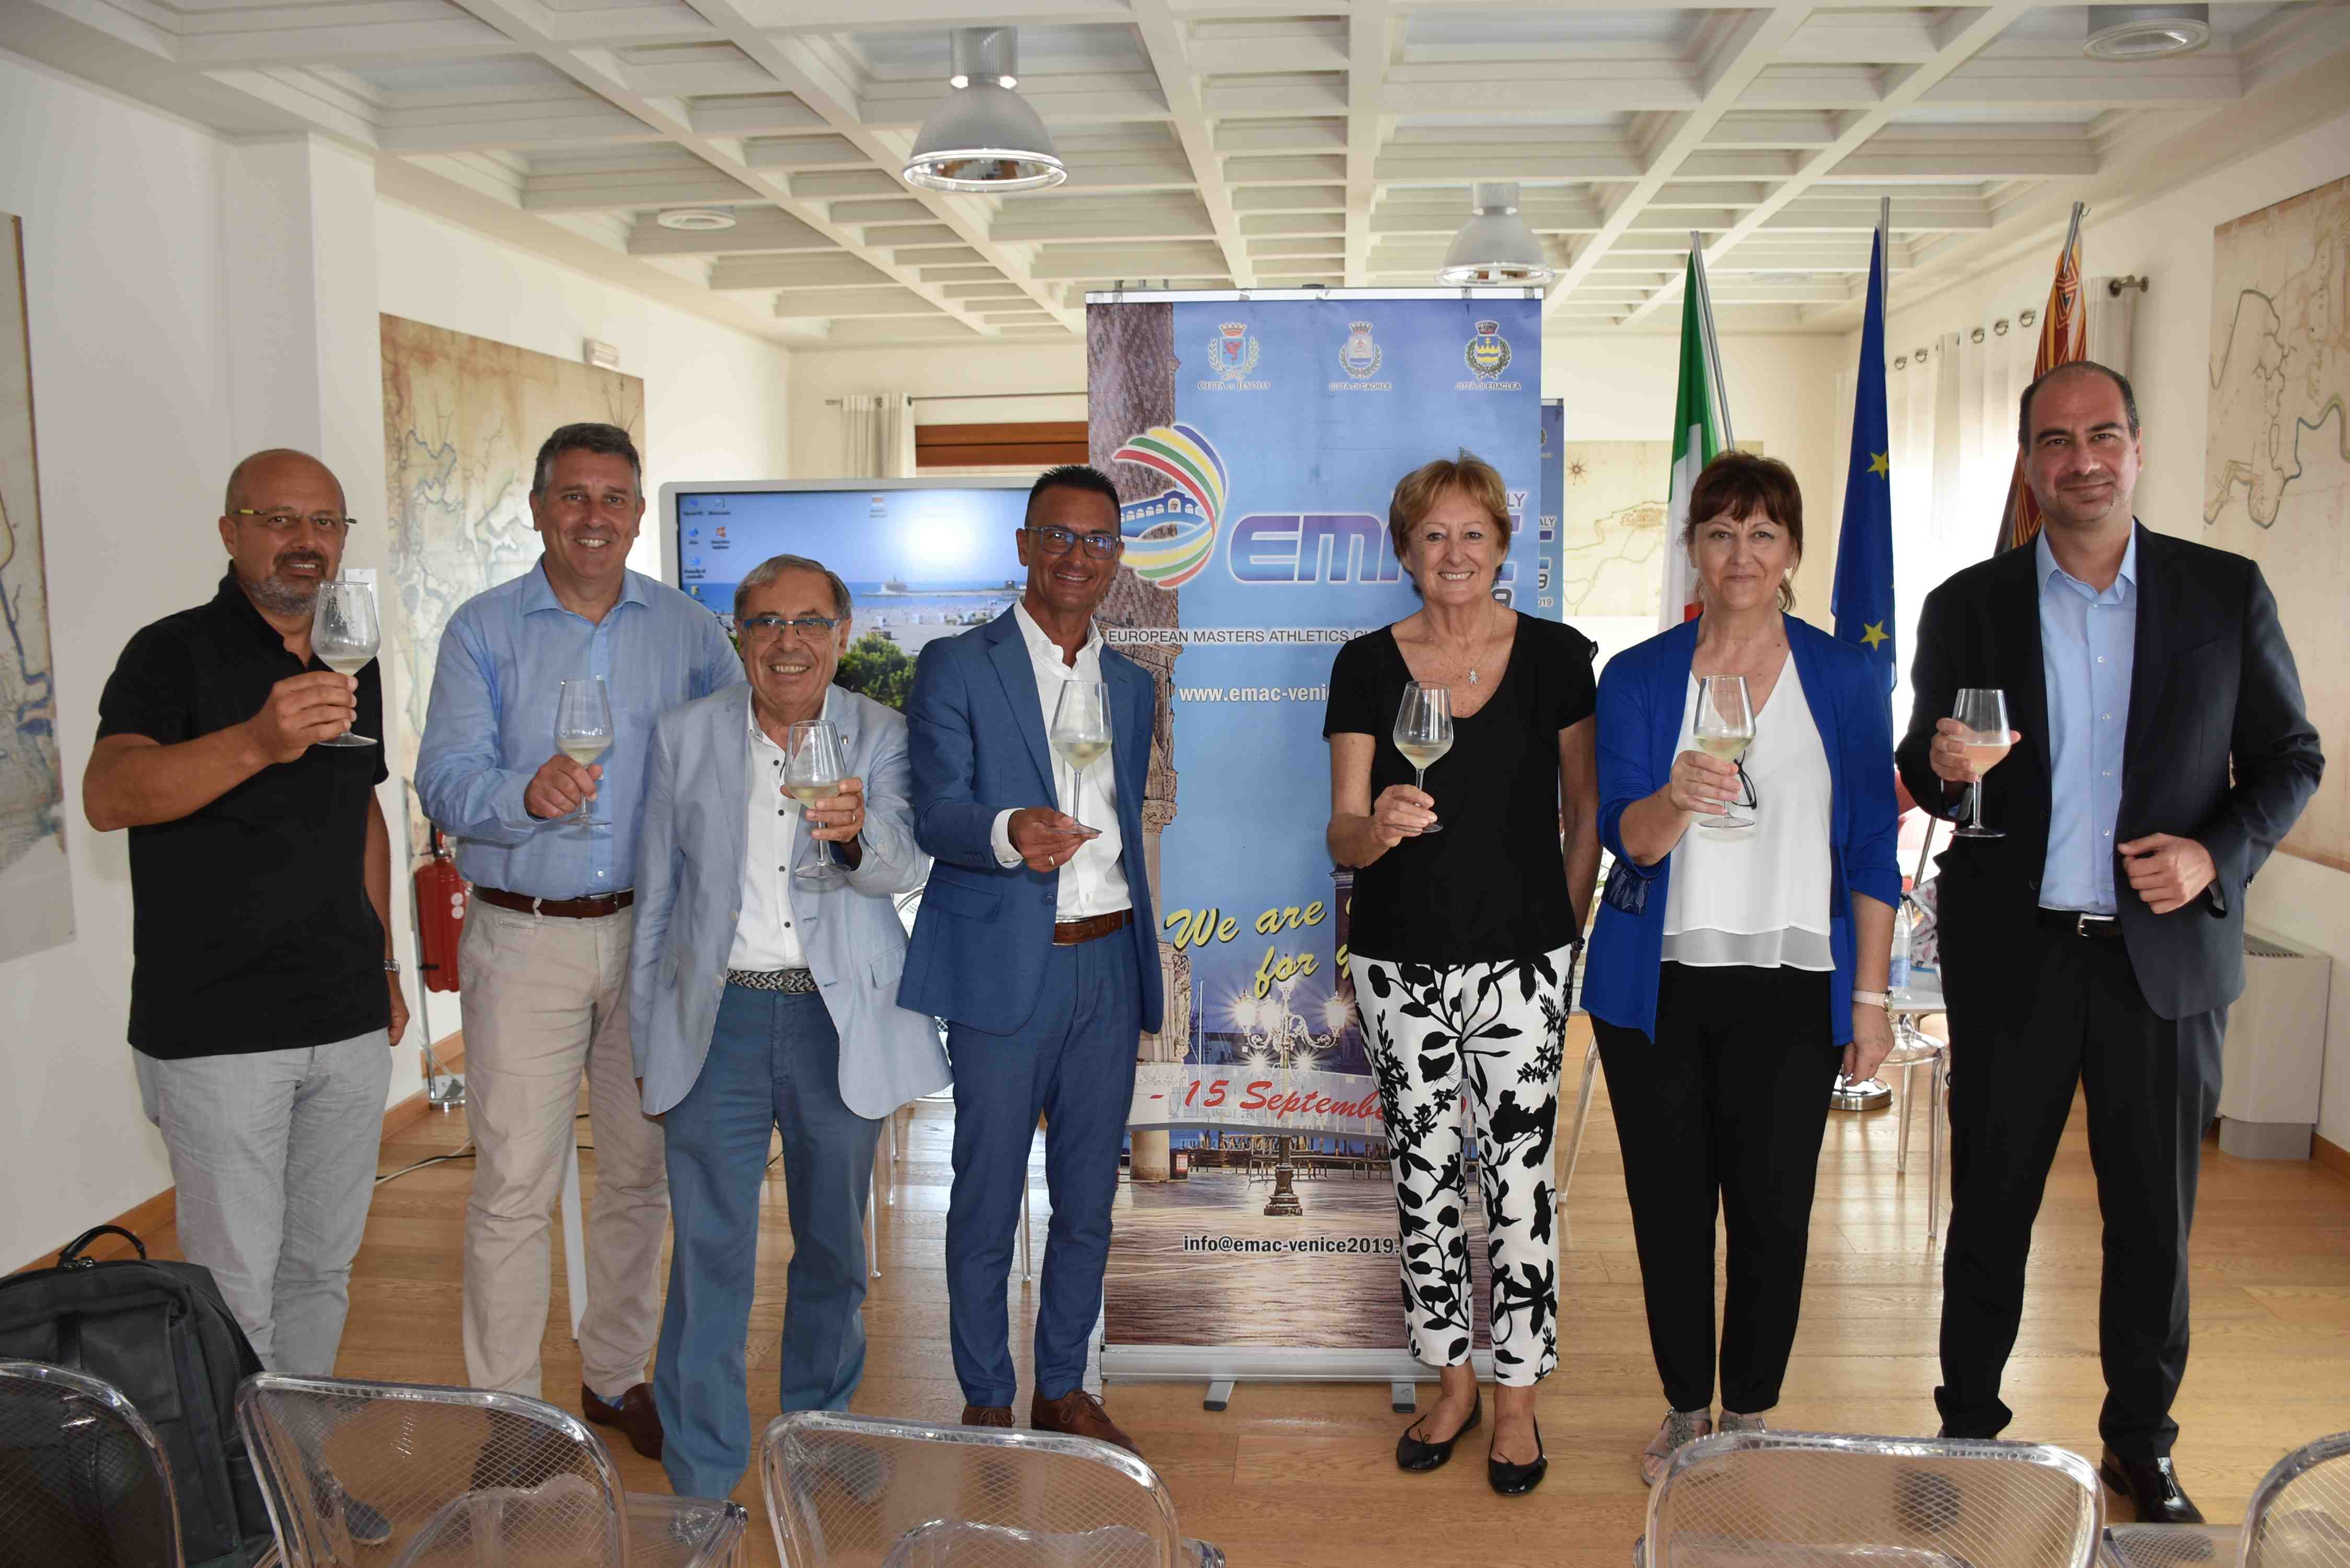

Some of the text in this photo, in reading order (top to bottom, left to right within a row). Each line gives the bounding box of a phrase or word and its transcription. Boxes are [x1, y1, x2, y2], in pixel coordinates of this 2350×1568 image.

[1238, 381, 1270, 389] JESOLO
[1108, 630, 1189, 642] EUROPEAN
[1193, 630, 1265, 642] MASTERS
[1269, 630, 1349, 642] ATHLETICS
[1179, 683, 1329, 701] www.emac-veni
[1165, 907, 1240, 951] We
[1255, 900, 1327, 935] are
[1254, 945, 1319, 999] for
[1184, 1079, 1228, 1107] 15
[1239, 1081, 1384, 1120] Septembe
[1184, 1235, 1400, 1253] info@emac-venice2019.
